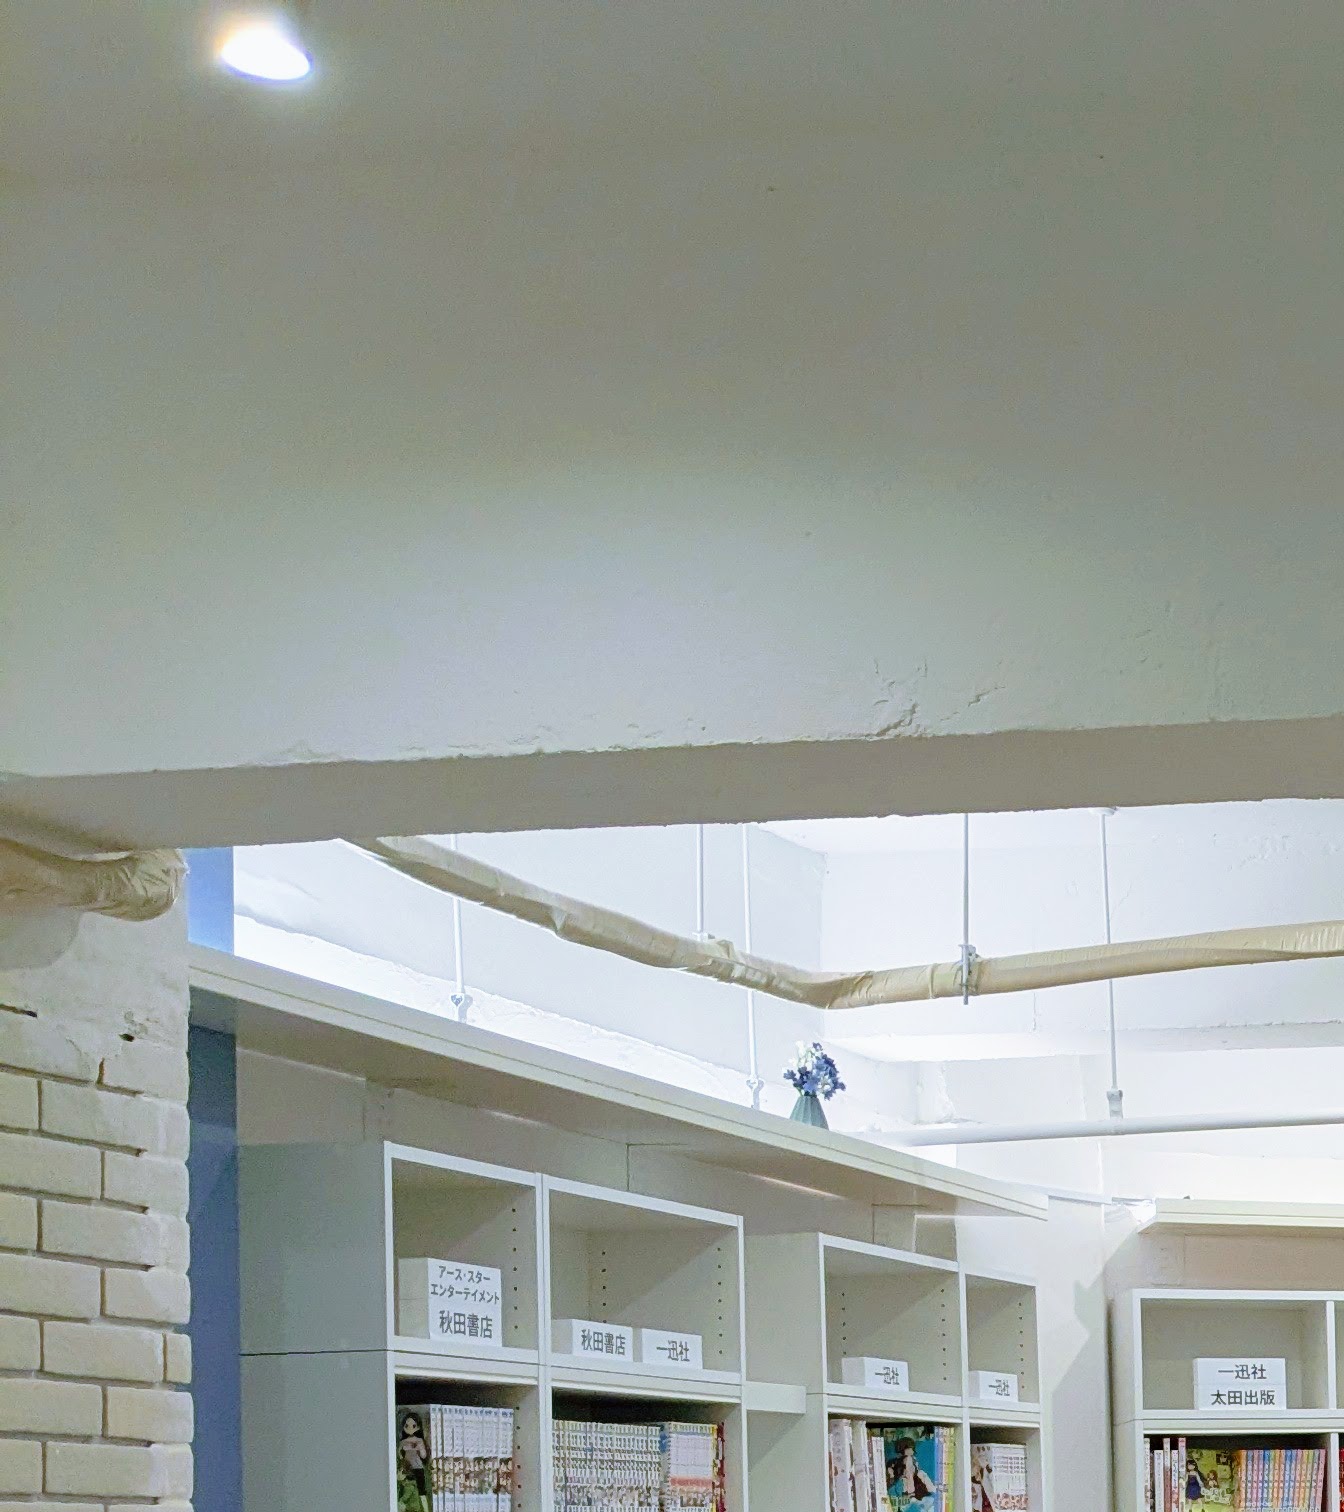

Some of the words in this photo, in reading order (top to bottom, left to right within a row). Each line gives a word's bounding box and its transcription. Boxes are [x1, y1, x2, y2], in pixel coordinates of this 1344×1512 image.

[438, 1309, 493, 1339] 秋田書店
[581, 1328, 626, 1356] 秋田書店
[656, 1339, 690, 1362] 一迅社
[1218, 1363, 1267, 1380] 一迅社
[1210, 1389, 1276, 1406] 太田出版
